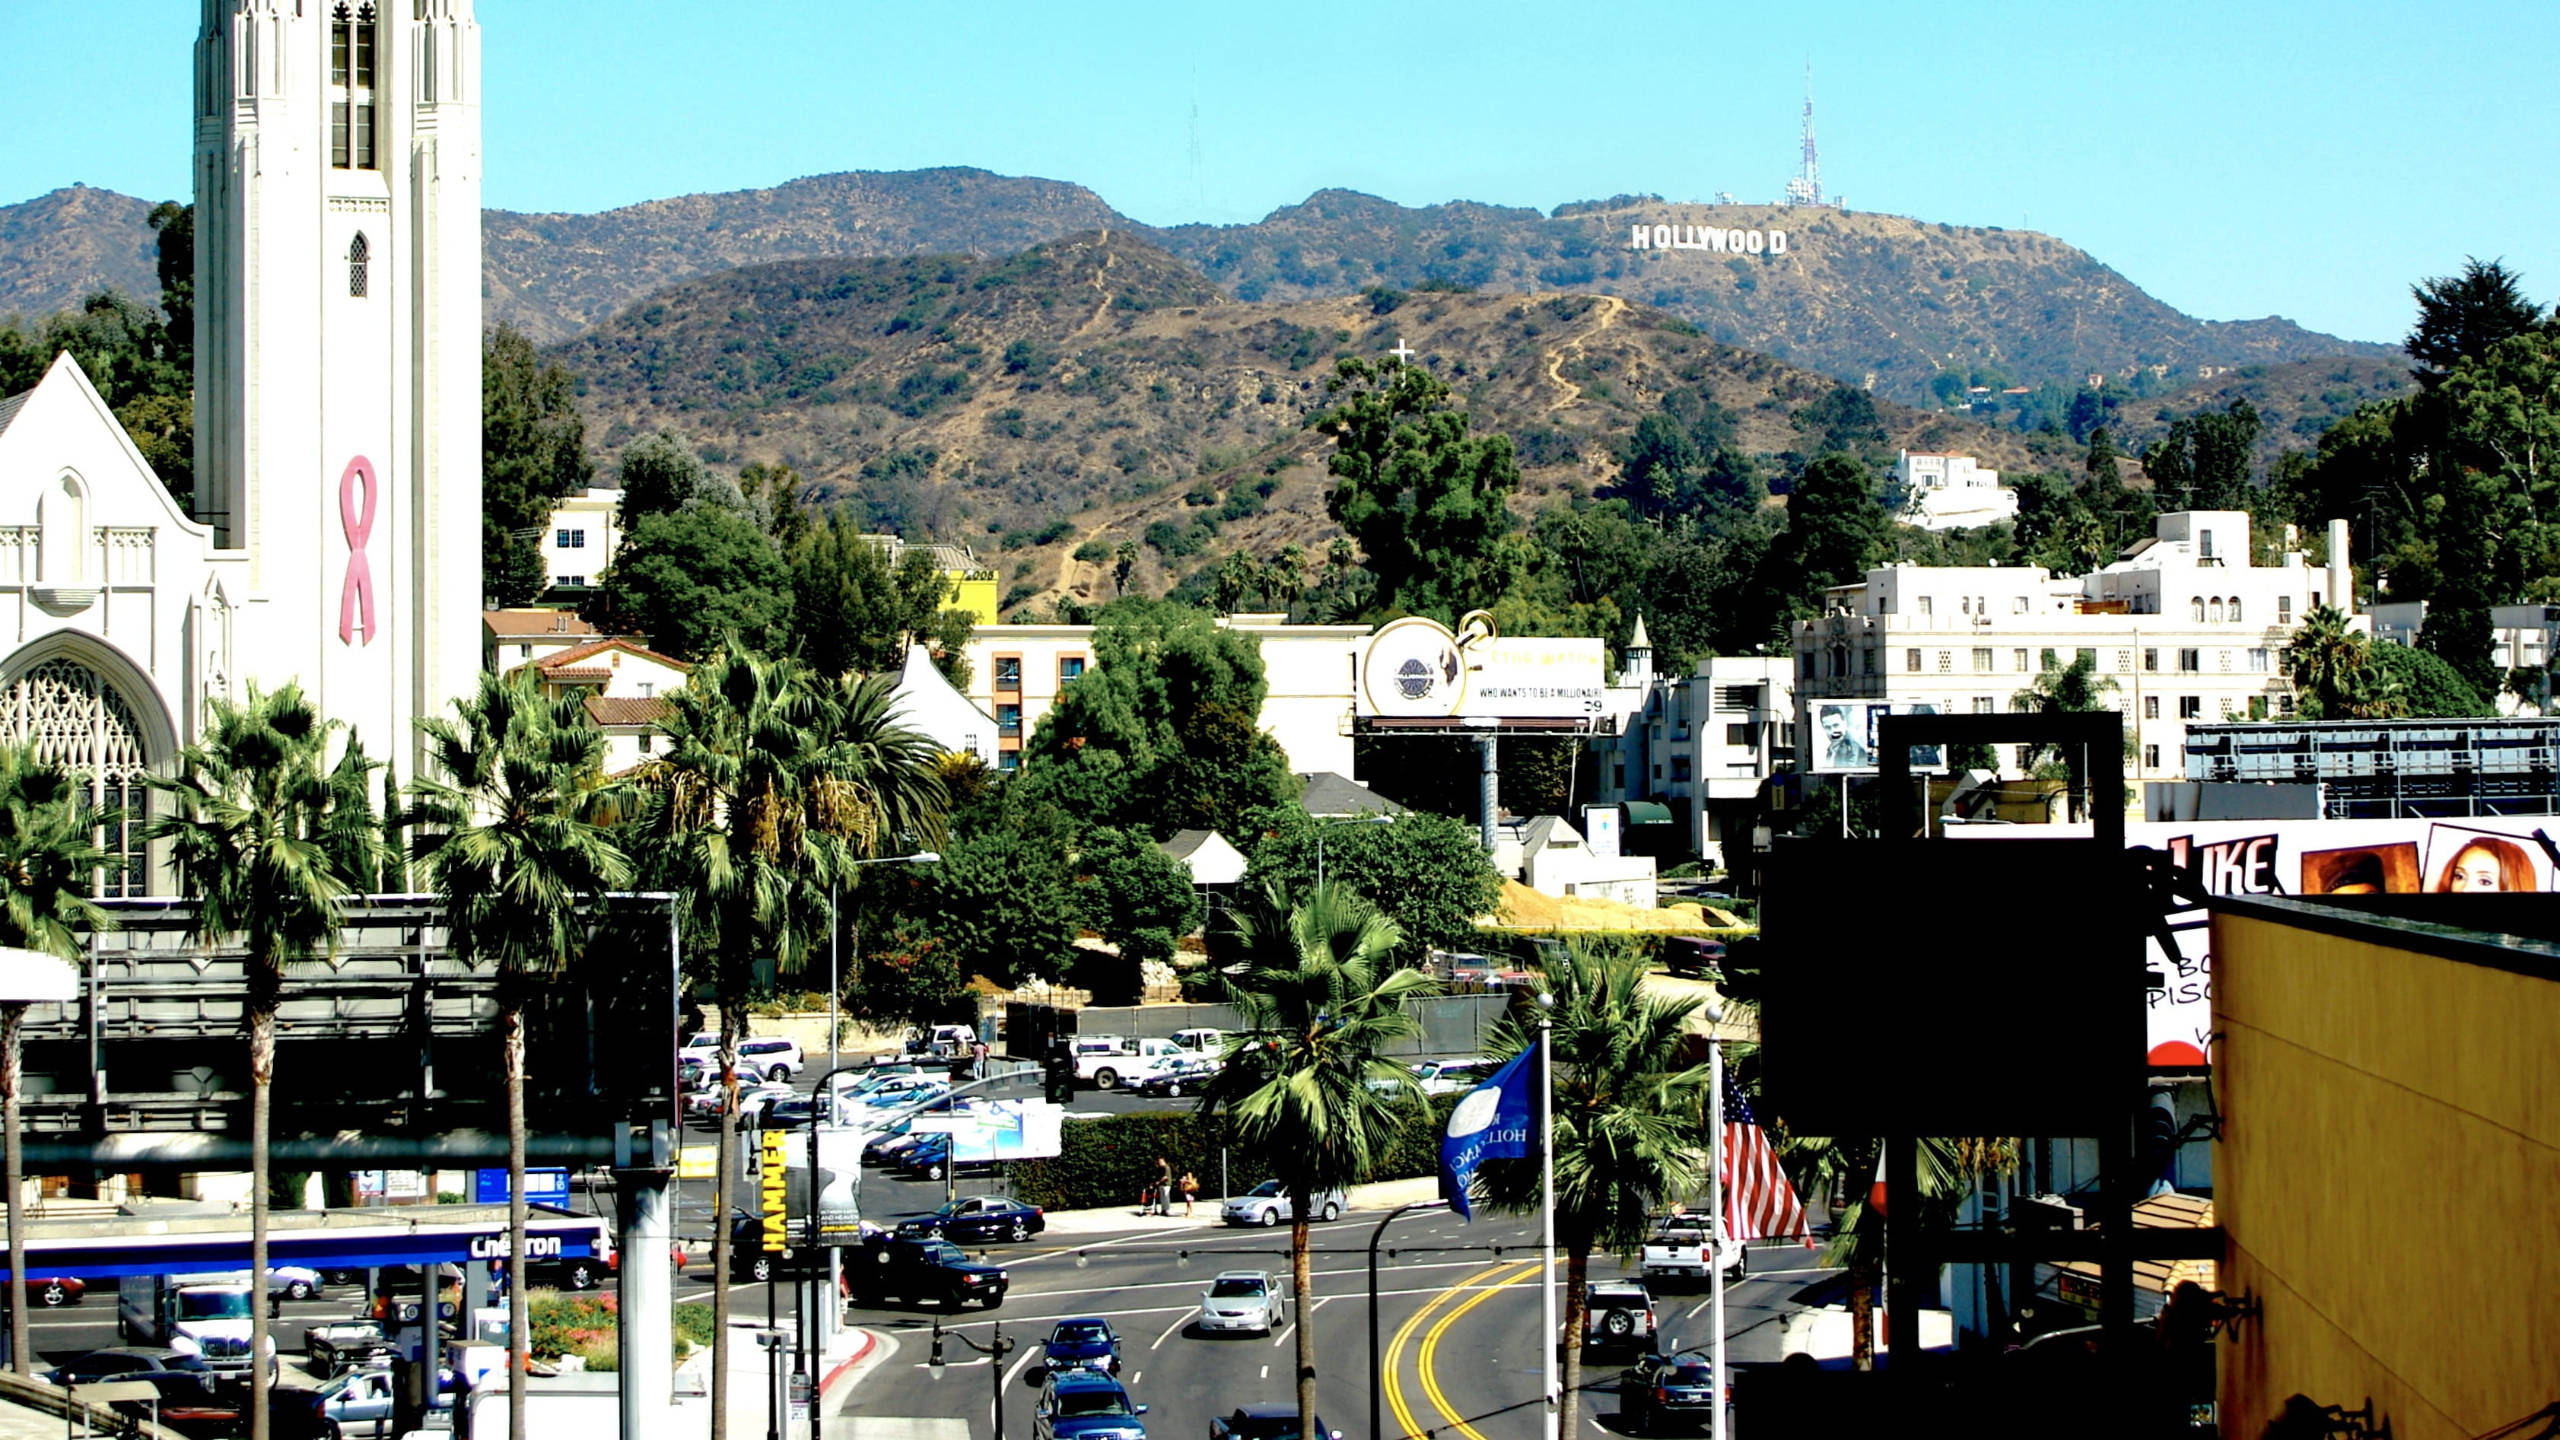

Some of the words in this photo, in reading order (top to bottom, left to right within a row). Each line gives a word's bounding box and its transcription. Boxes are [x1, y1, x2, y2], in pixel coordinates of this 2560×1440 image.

[1632, 225, 1787, 254] HOLLYWOOD
[1480, 688, 1498, 698] WHO
[1500, 688, 1527, 698] WANTS
[1529, 688, 1538, 698] TO
[1540, 688, 1548, 698] BE
[1557, 688, 1602, 698] MILLIONAIRE
[762, 1130, 786, 1251] HAMMER
[471, 1235, 561, 1258] Cheron
